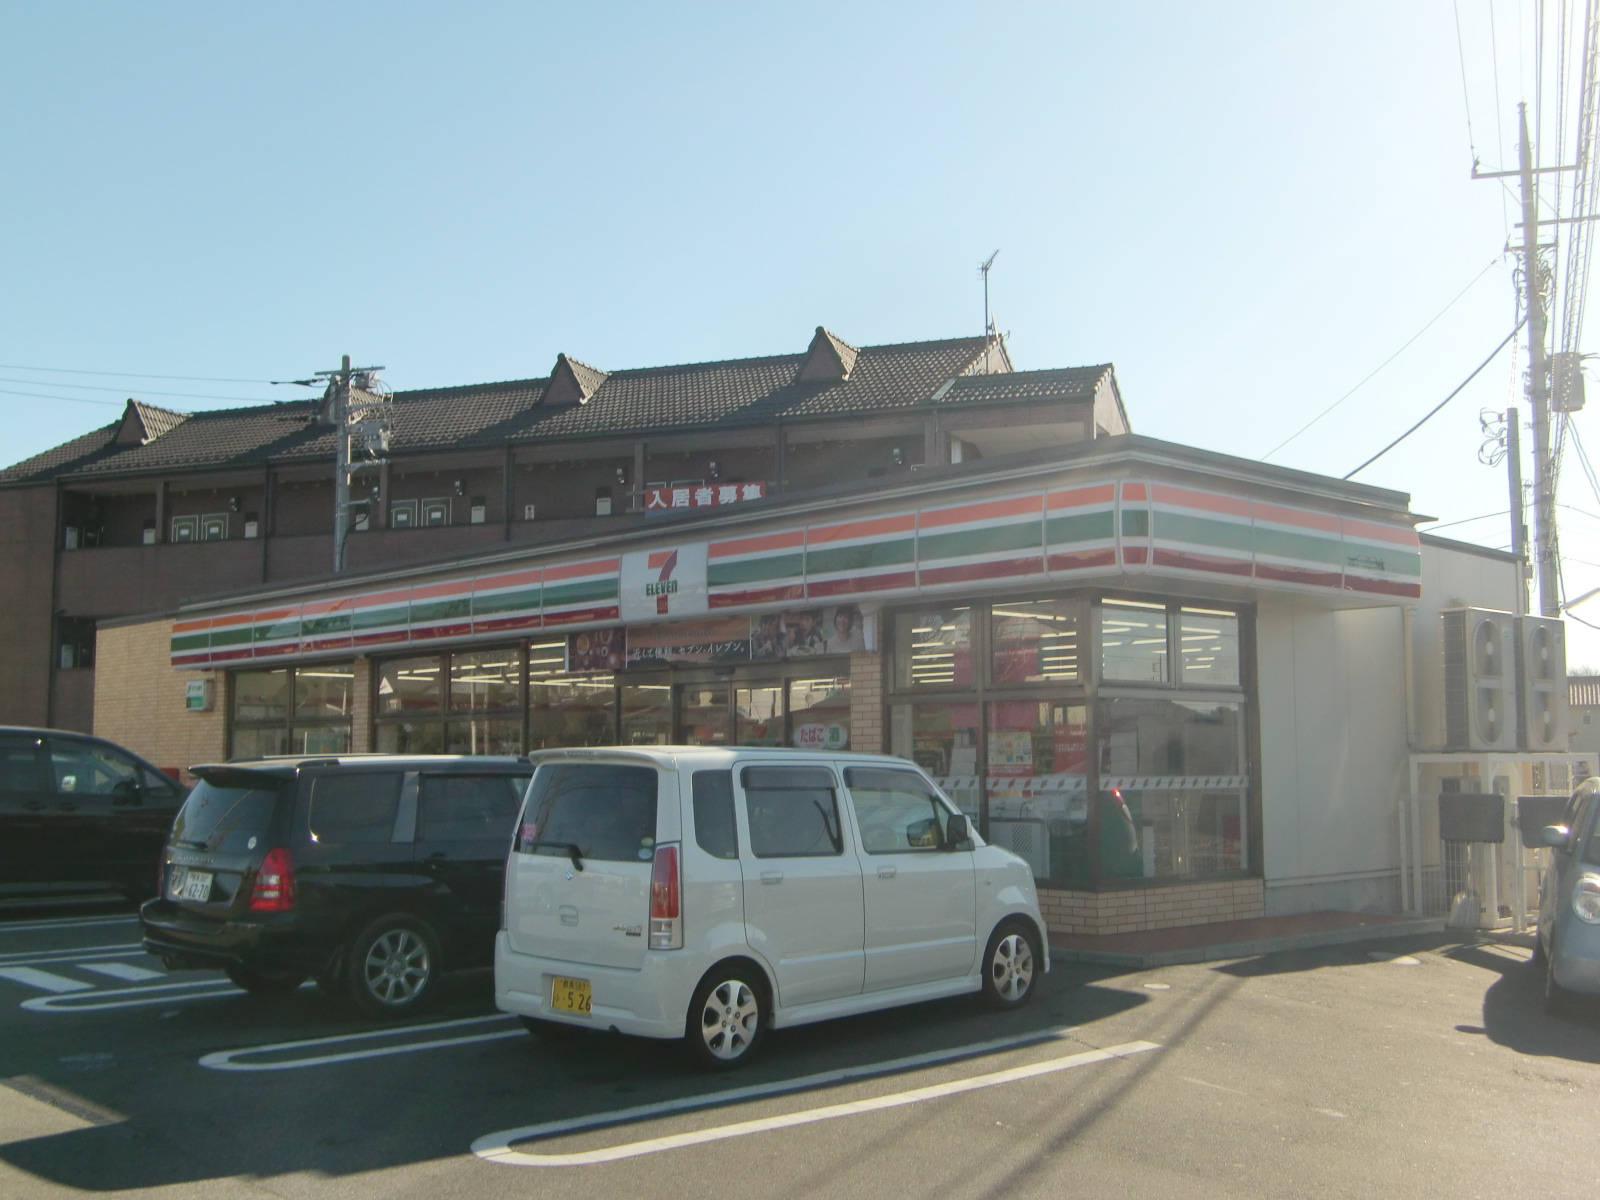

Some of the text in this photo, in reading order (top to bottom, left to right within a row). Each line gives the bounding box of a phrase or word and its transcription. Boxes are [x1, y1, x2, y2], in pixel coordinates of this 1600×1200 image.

[648, 483, 762, 509] 入居者募集
[800, 727, 825, 743] たばこ
